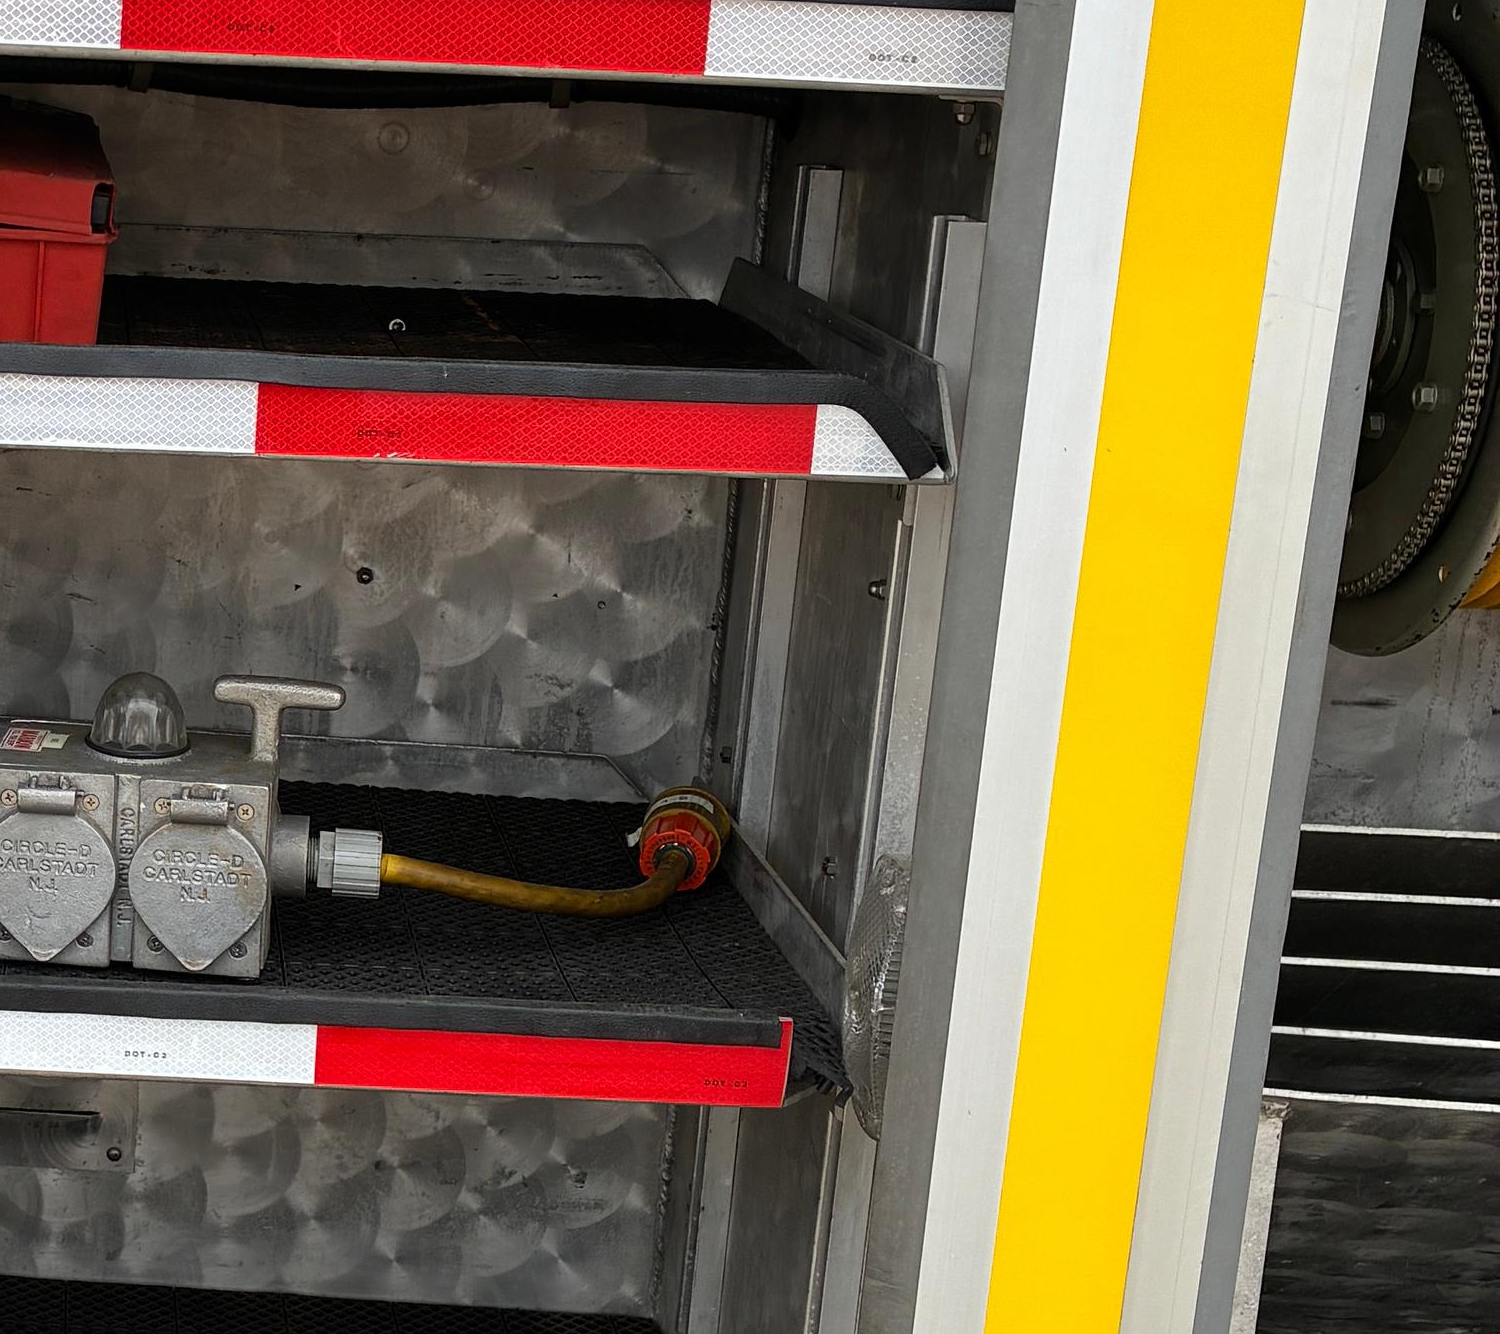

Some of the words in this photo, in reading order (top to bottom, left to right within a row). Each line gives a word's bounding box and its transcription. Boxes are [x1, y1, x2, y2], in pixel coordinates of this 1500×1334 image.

[1, 839, 91, 858] CIRCLE-D
[152, 849, 244, 870] CIRCLE-D
[143, 866, 252, 888] CARLSTADT
